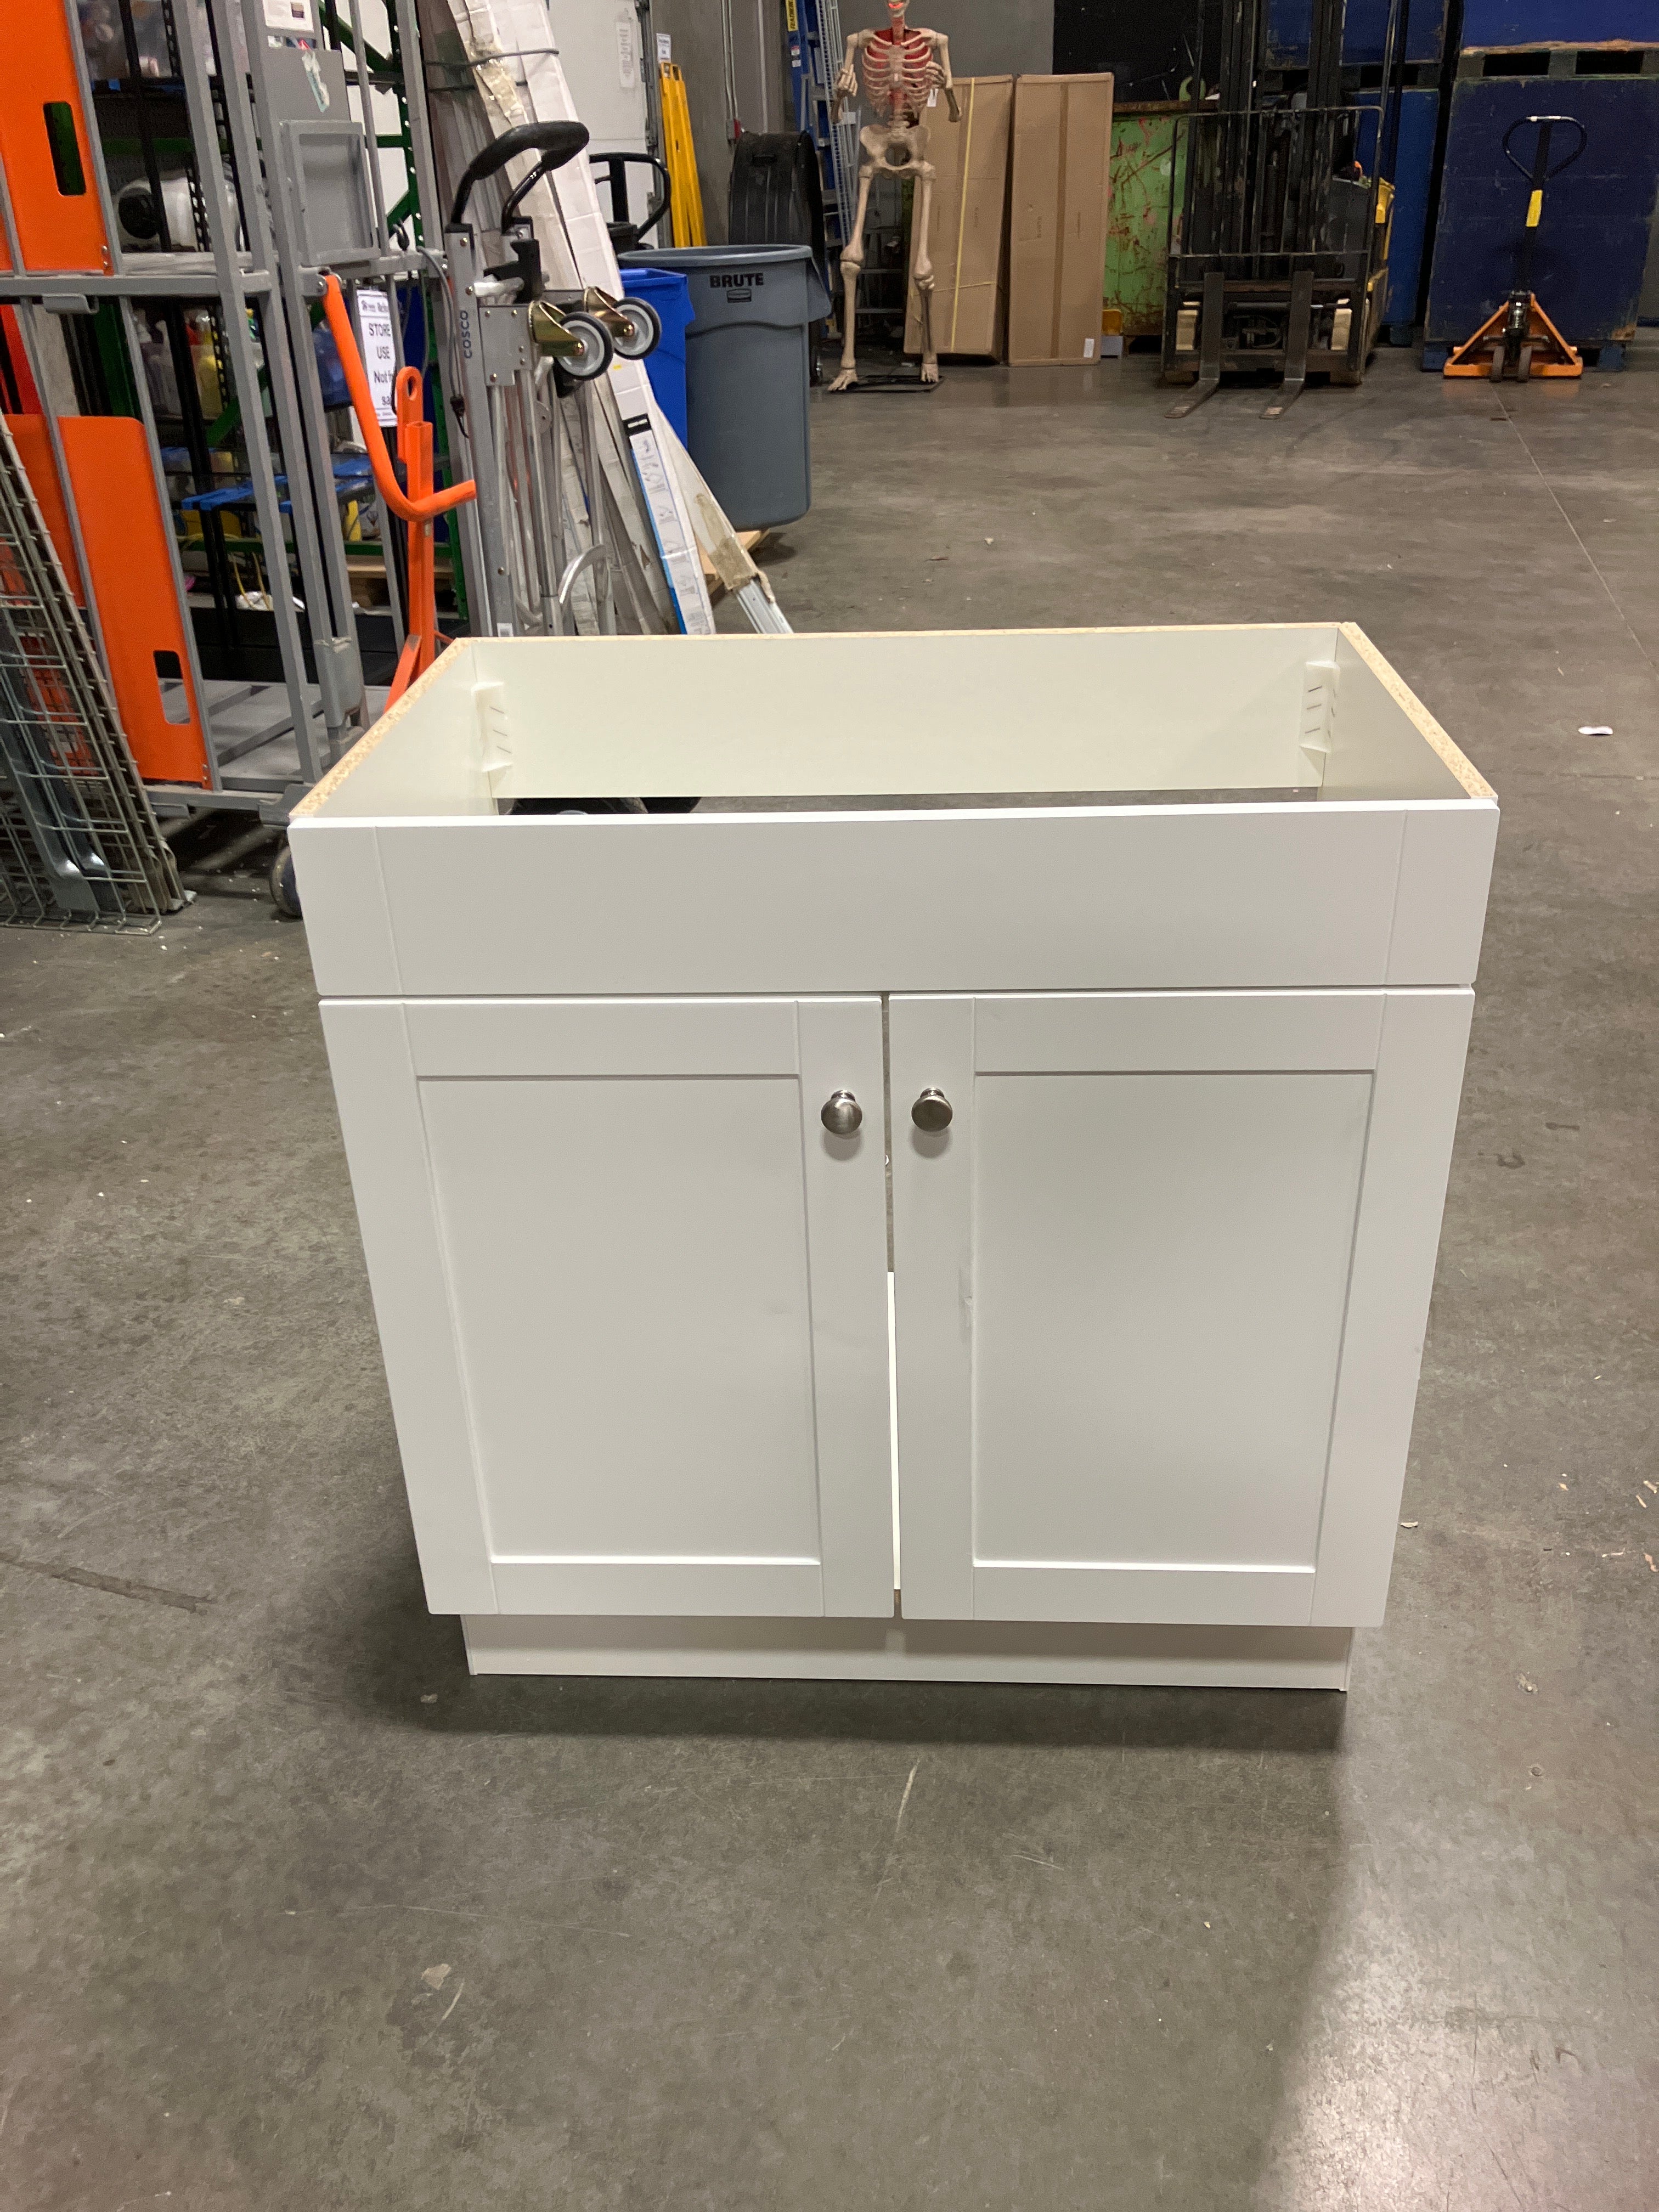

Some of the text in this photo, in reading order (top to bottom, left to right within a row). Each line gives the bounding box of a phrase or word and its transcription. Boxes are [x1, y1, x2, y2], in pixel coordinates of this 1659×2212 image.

[710, 273, 763, 288] BRUTE
[368, 323, 391, 337] STORE
[460, 310, 472, 359] COSCO
[376, 346, 390, 359] USE
[374, 370, 388, 383] Not
